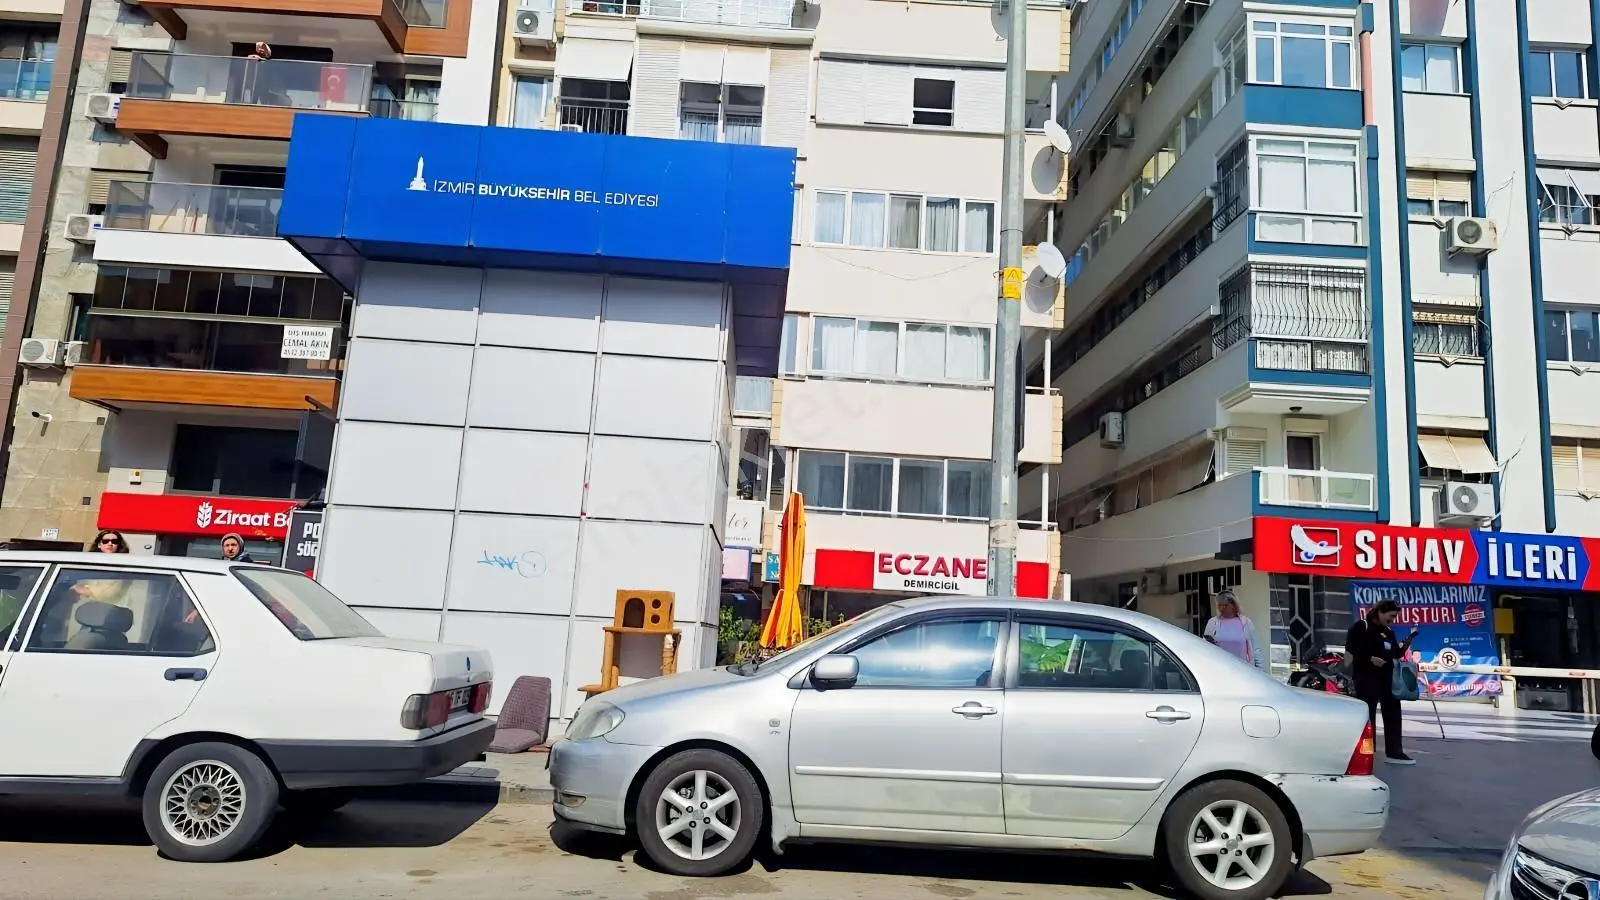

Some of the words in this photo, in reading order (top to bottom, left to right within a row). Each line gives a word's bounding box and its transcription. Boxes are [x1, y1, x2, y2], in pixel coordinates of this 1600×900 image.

[213, 509, 271, 527] Ziraat
[1355, 529, 1464, 574] SINAV
[878, 553, 987, 579] ECZANE
[1353, 585, 1486, 605] KONTENJANLARIMIZ
